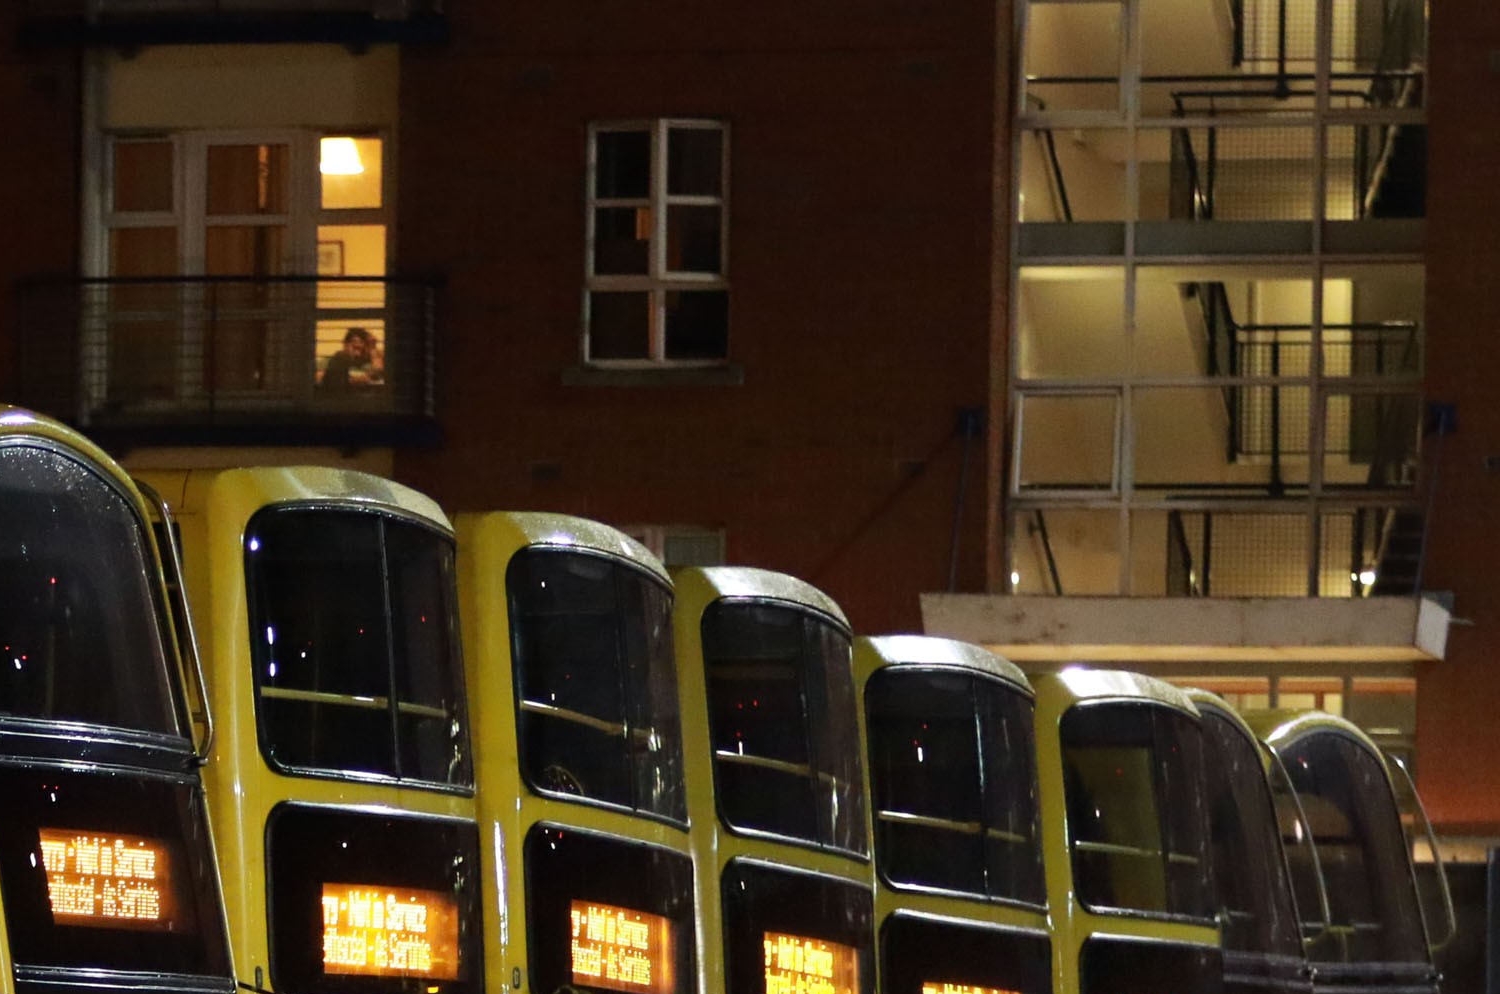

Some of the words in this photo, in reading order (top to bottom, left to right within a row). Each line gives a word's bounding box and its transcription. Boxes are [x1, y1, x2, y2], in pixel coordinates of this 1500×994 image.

[77, 837, 99, 874] Not
[101, 839, 112, 875] in
[115, 840, 155, 878] Service
